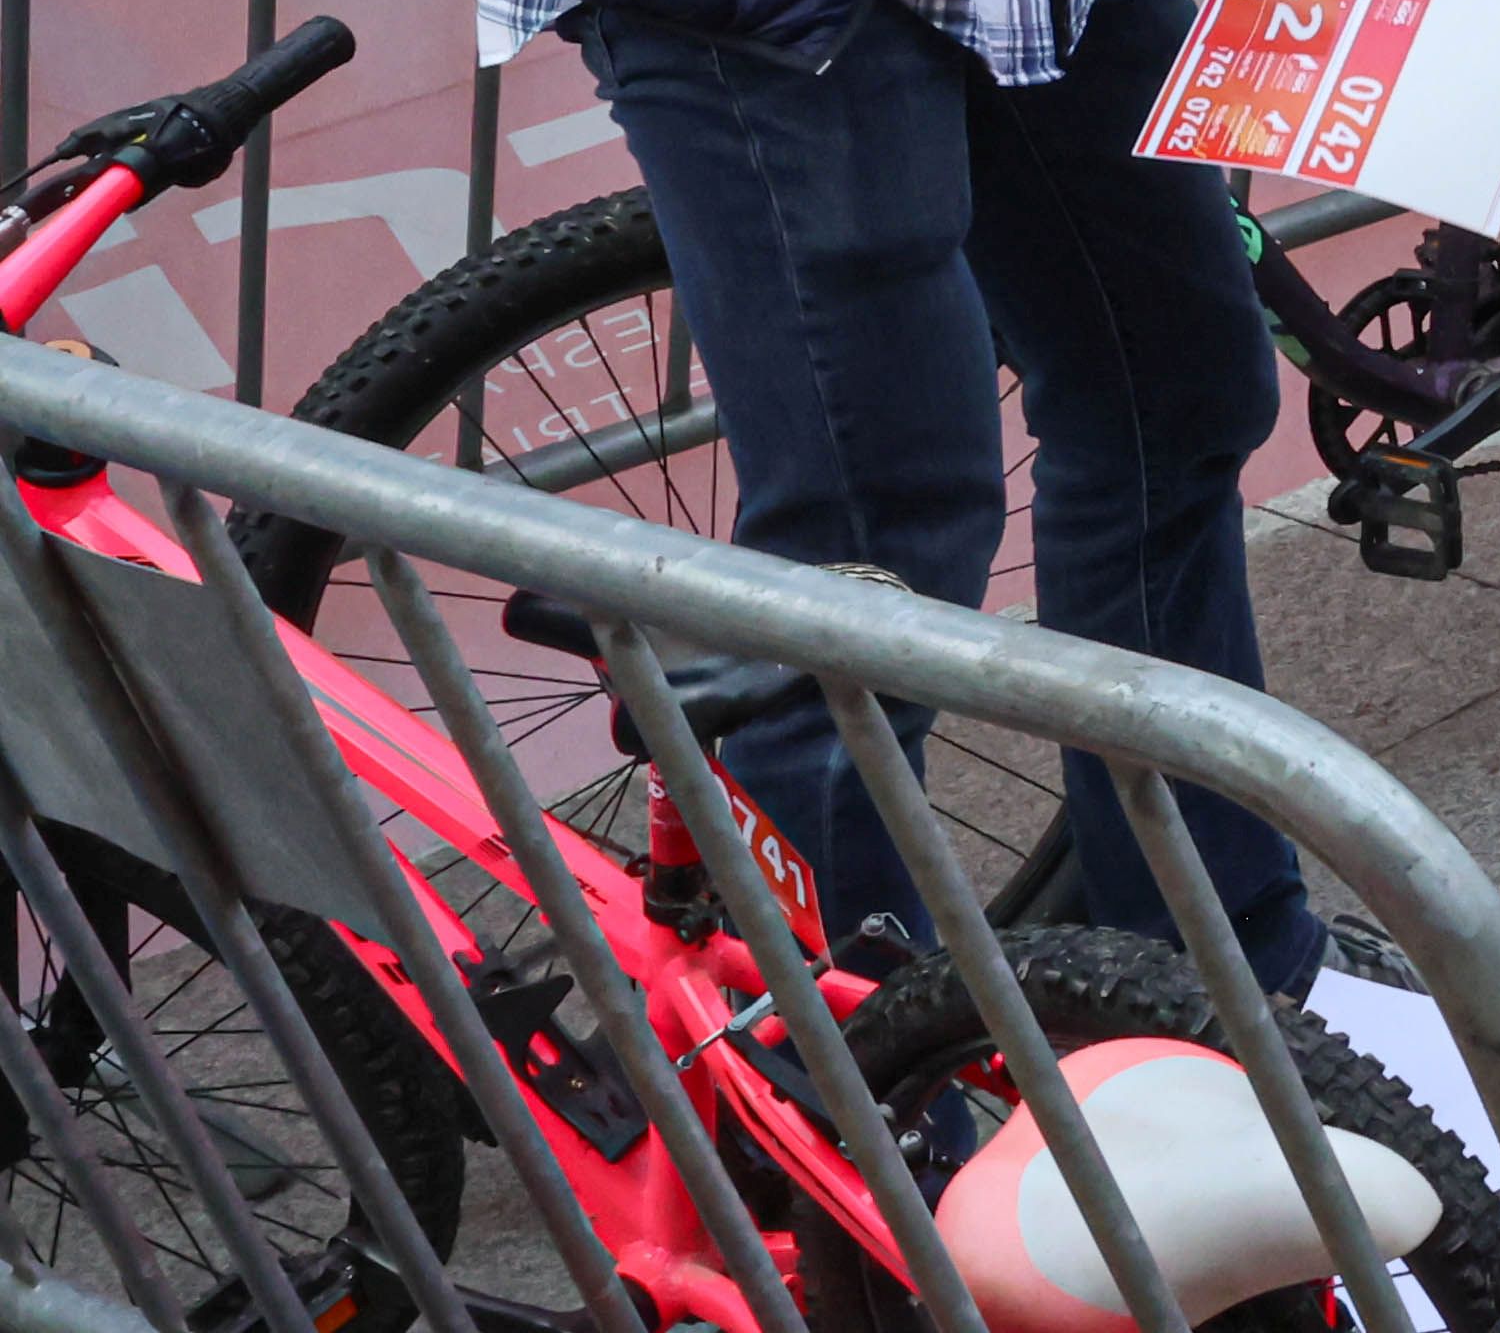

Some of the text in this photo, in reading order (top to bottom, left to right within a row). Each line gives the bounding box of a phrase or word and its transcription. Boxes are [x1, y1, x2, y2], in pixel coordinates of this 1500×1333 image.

[1167, 96, 1212, 152] 0742
[1308, 75, 1384, 175] 0742
[715, 773, 806, 910] 741
